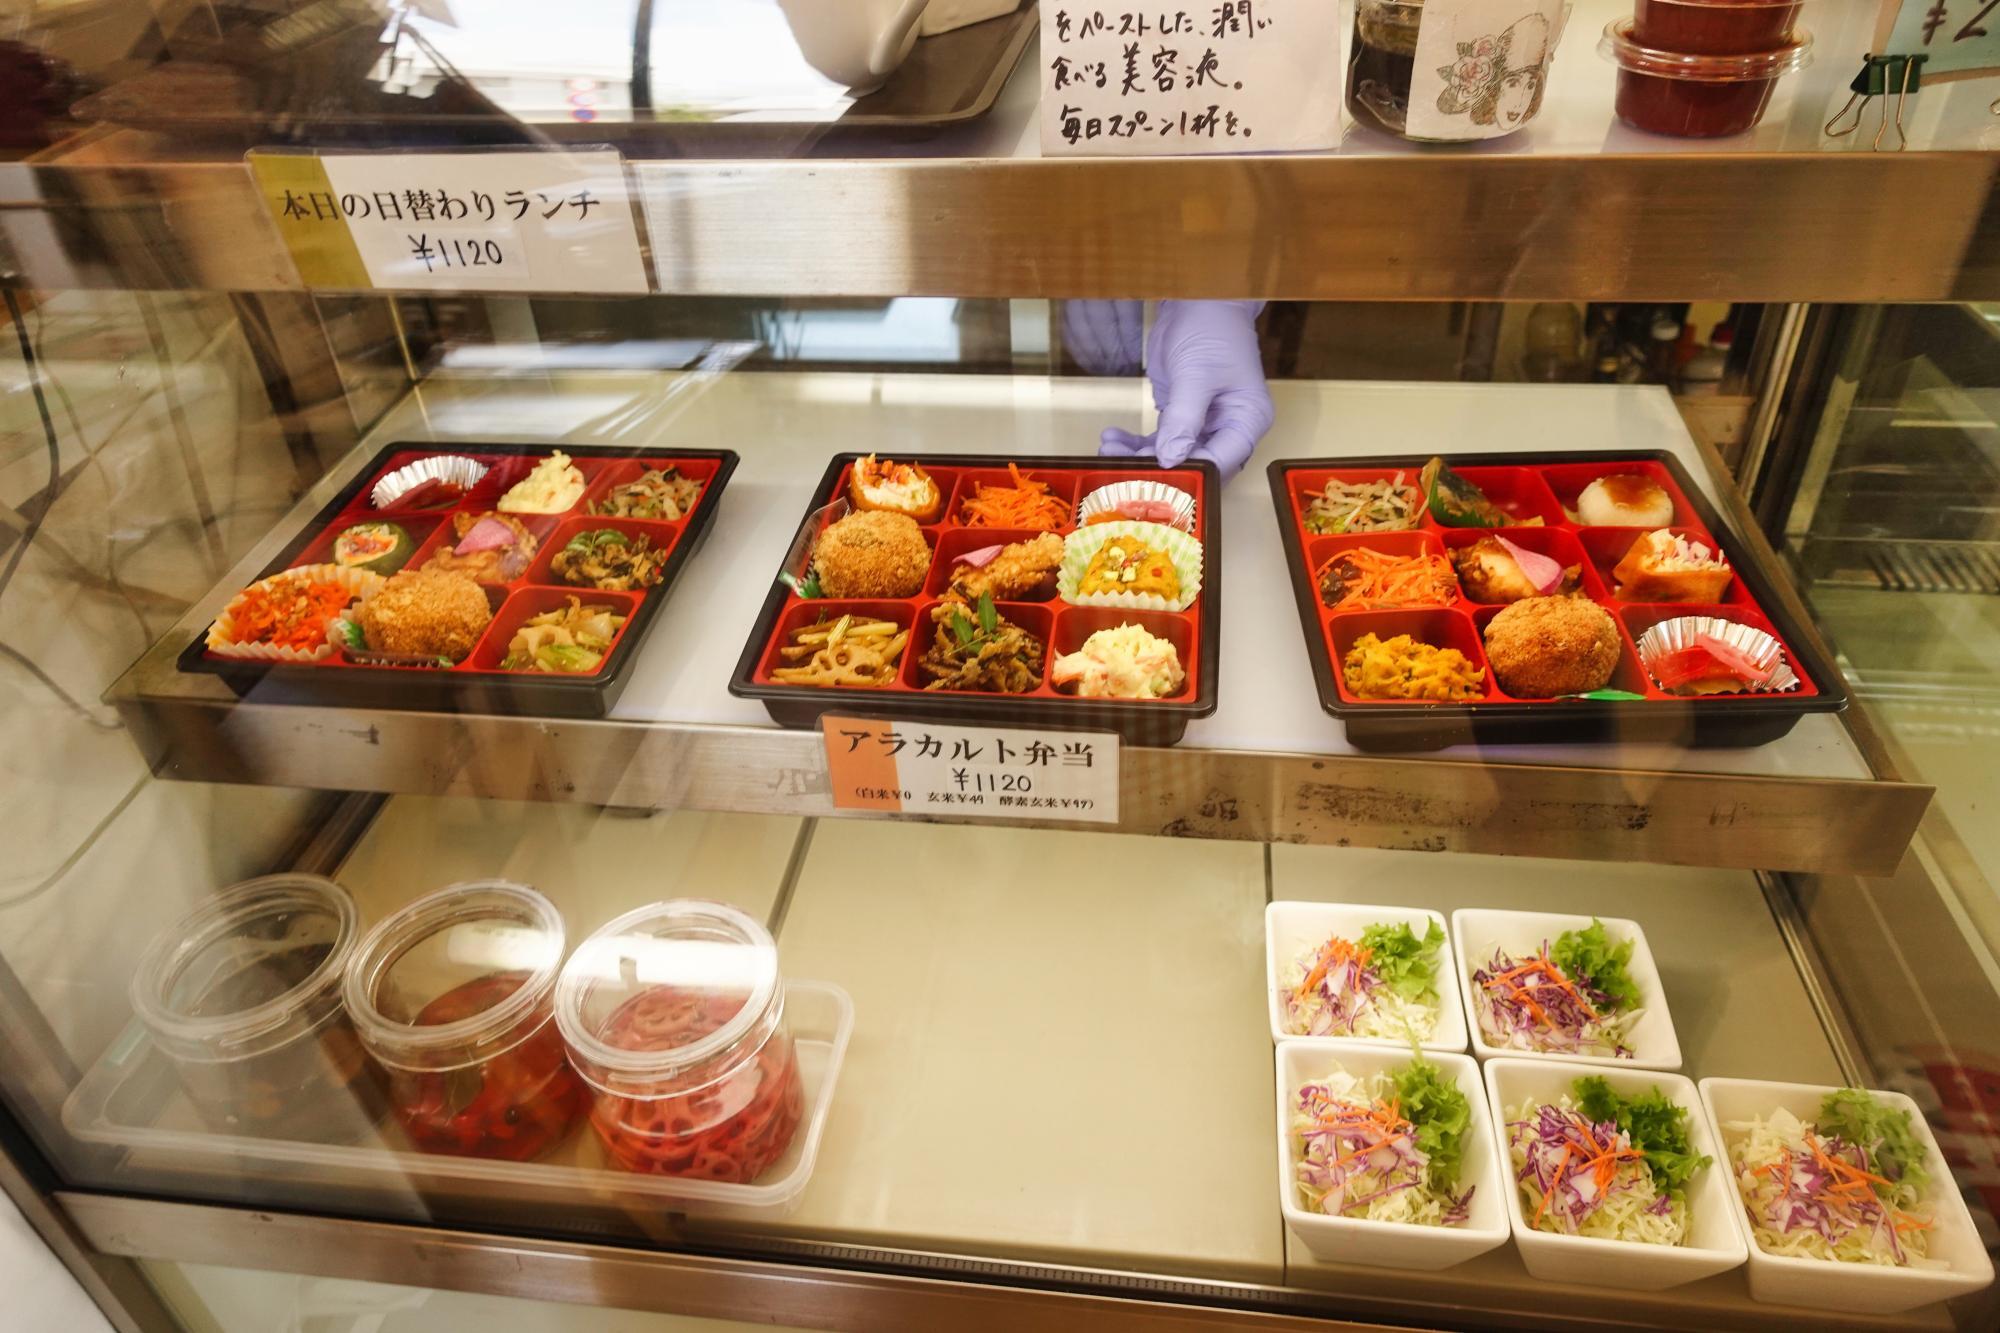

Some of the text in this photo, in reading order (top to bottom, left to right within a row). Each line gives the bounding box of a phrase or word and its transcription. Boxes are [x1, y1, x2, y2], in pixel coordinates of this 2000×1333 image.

[282, 188, 600, 221] 本日の日替わりランチ
[407, 233, 503, 273] ¥1120
[839, 729, 1095, 768] アラカルト弁当
[951, 767, 1032, 792] ¥1120
